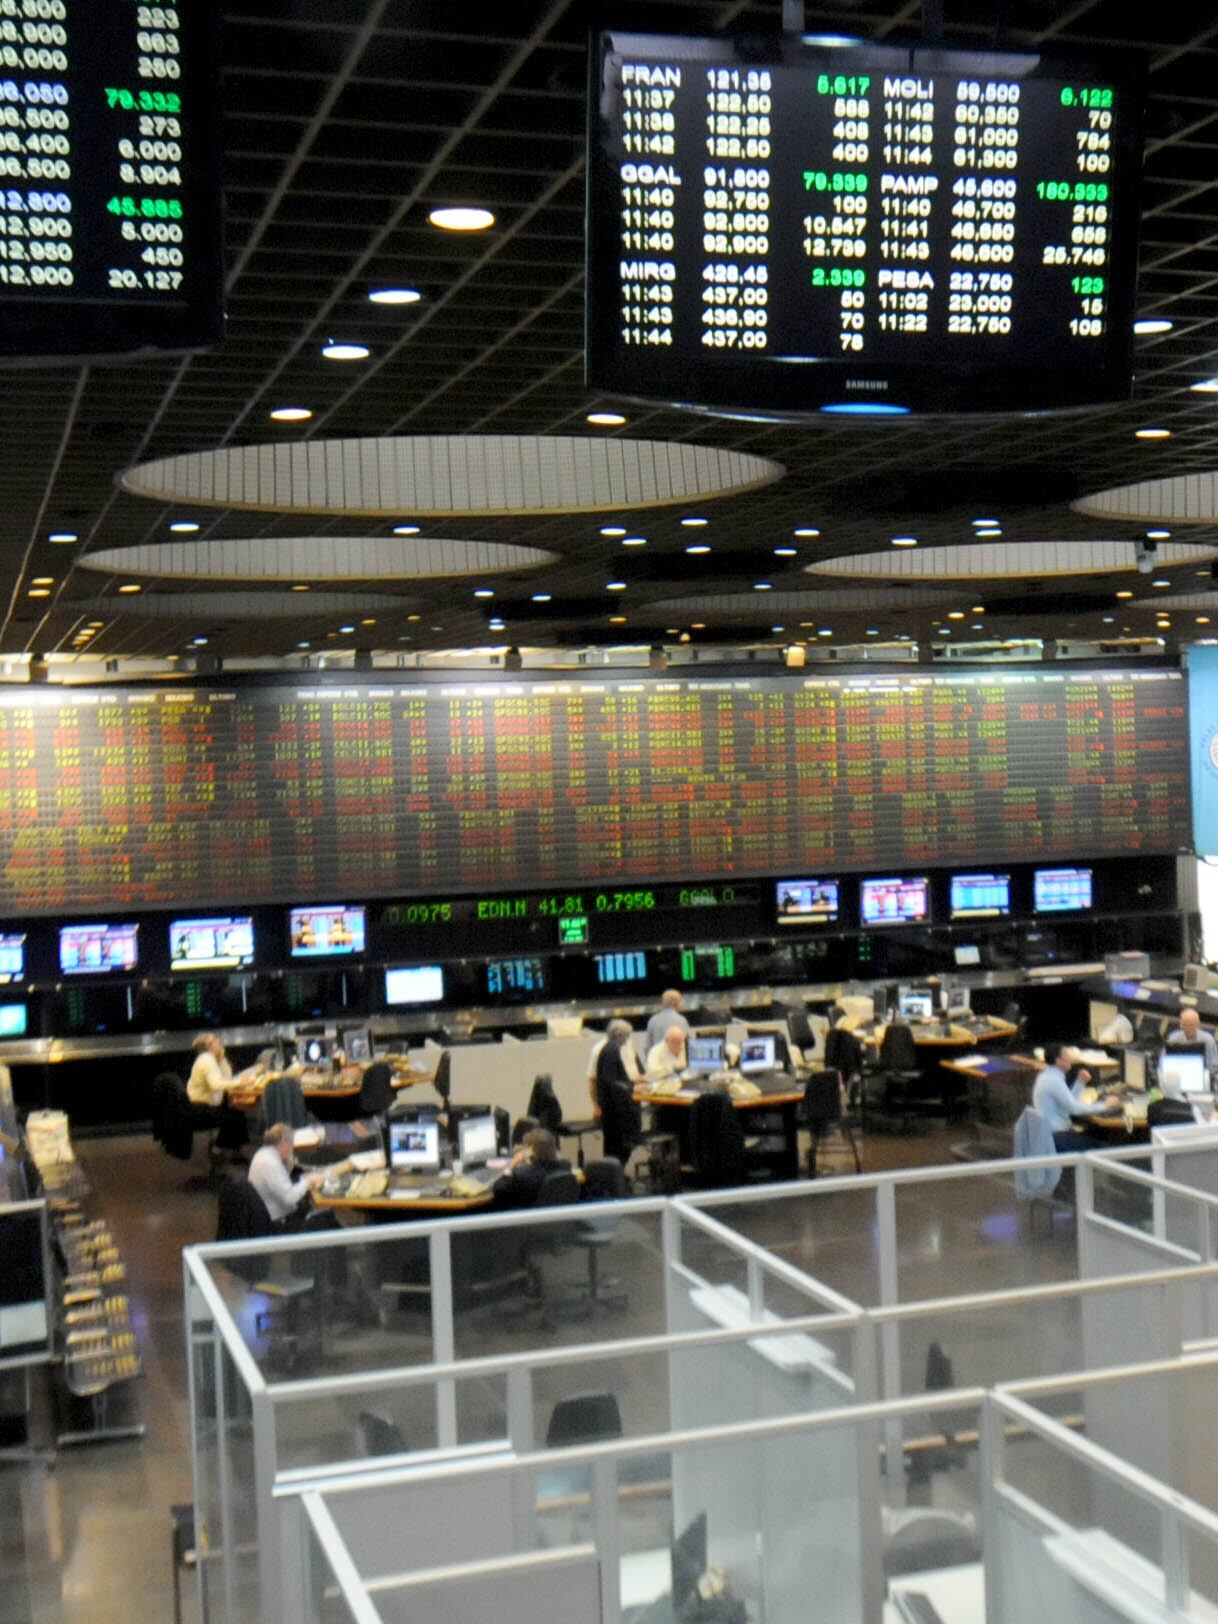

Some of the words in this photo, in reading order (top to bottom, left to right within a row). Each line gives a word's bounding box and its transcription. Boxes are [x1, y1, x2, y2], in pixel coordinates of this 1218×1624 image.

[622, 64, 680, 87] FRAN
[884, 77, 933, 99] MOLI
[881, 174, 938, 194] PAMP
[620, 261, 675, 280] MIRG
